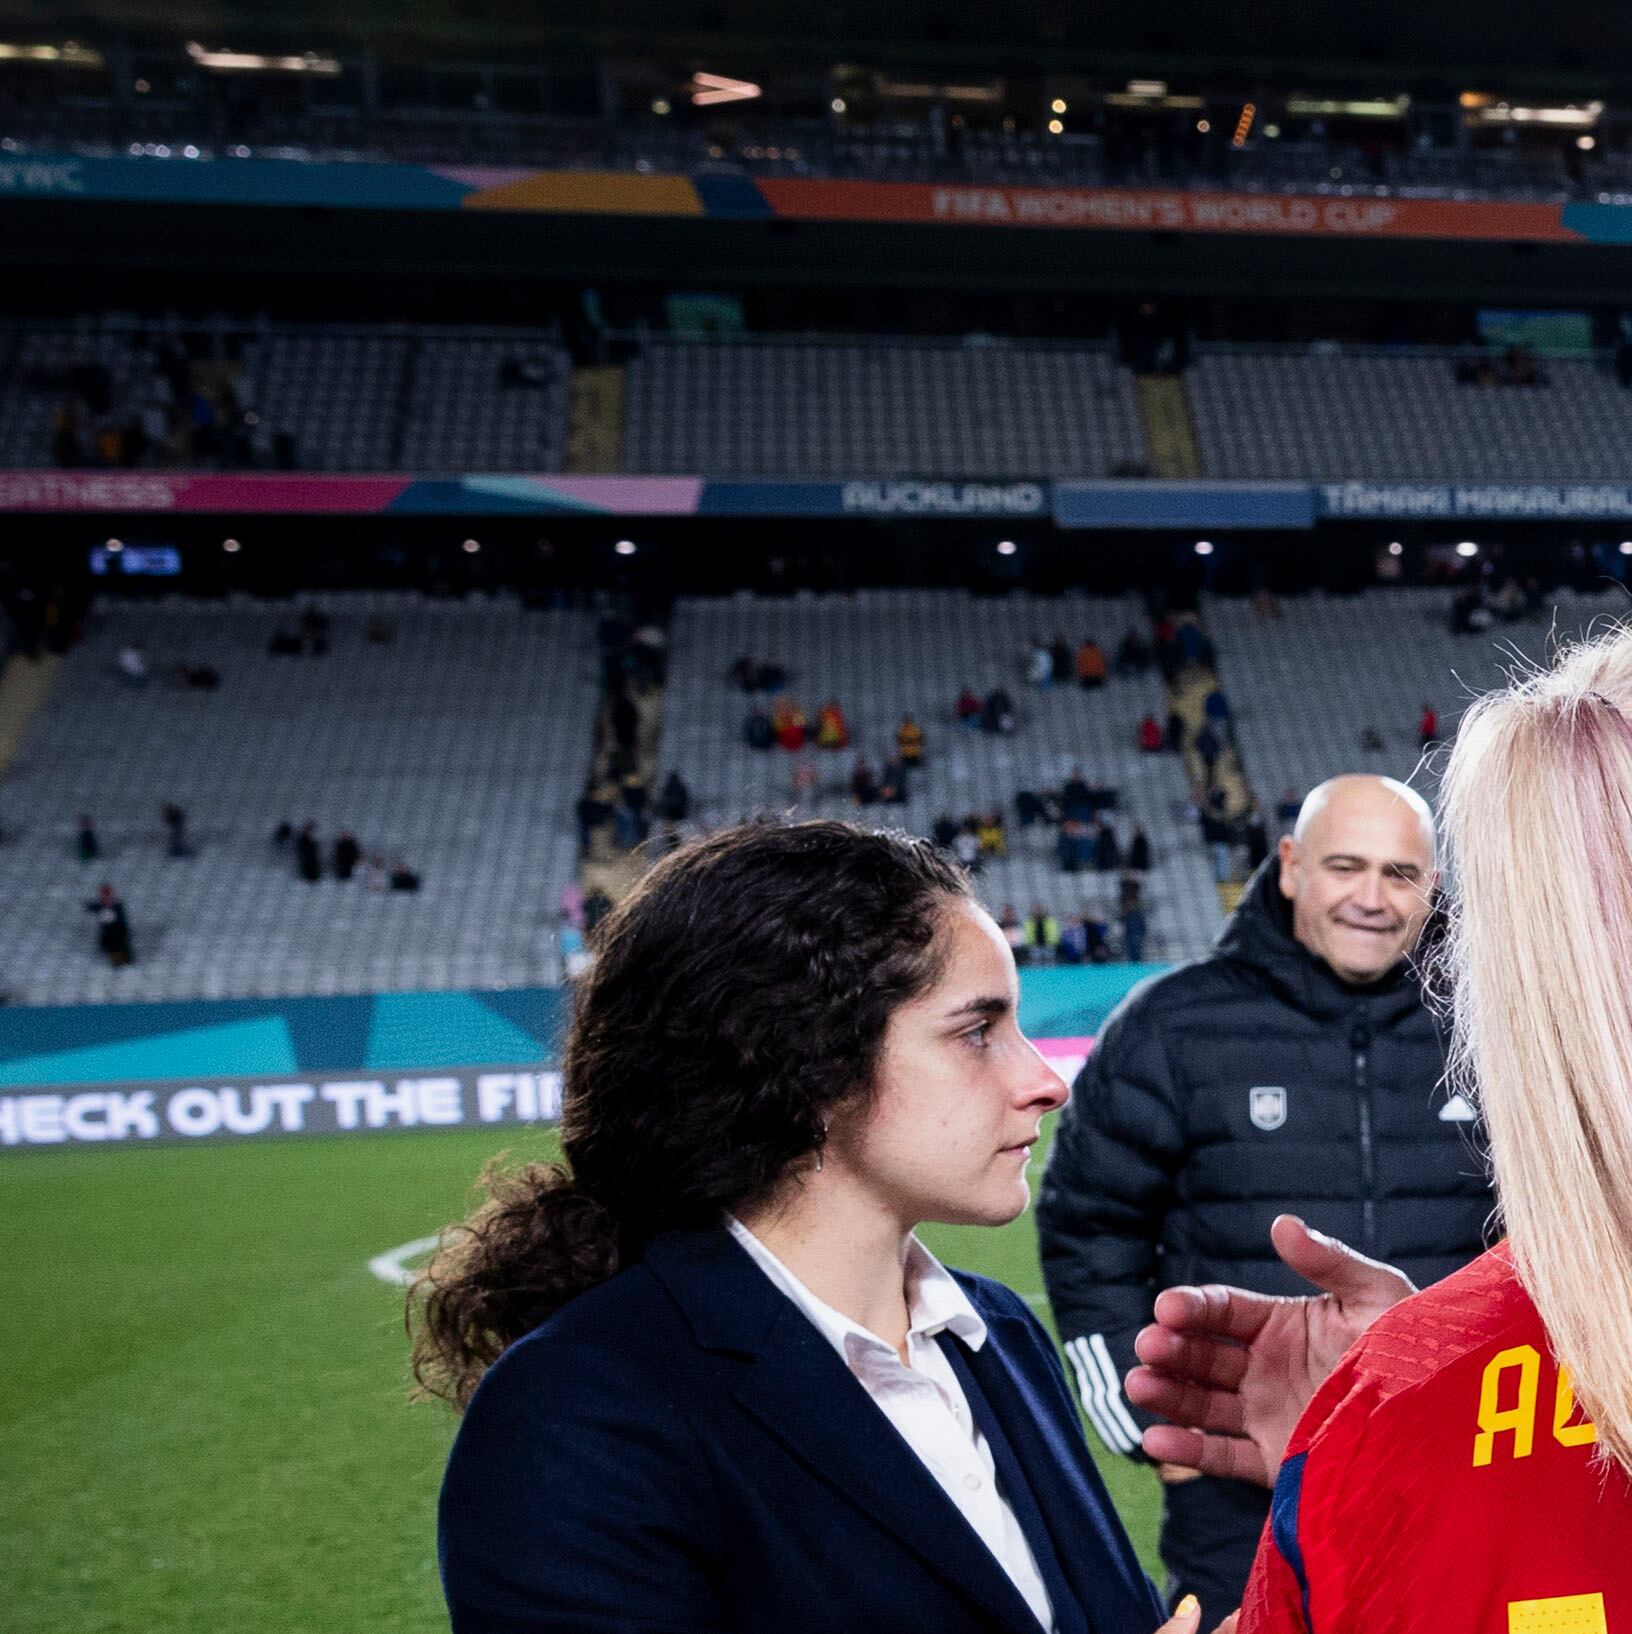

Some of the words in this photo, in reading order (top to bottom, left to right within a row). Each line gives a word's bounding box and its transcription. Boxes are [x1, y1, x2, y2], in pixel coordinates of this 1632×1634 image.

[1324, 201, 1397, 232] CUP
[841, 481, 1043, 513] AUCKLAND
[167, 1082, 316, 1136] OUT
[319, 1076, 464, 1131] THE
